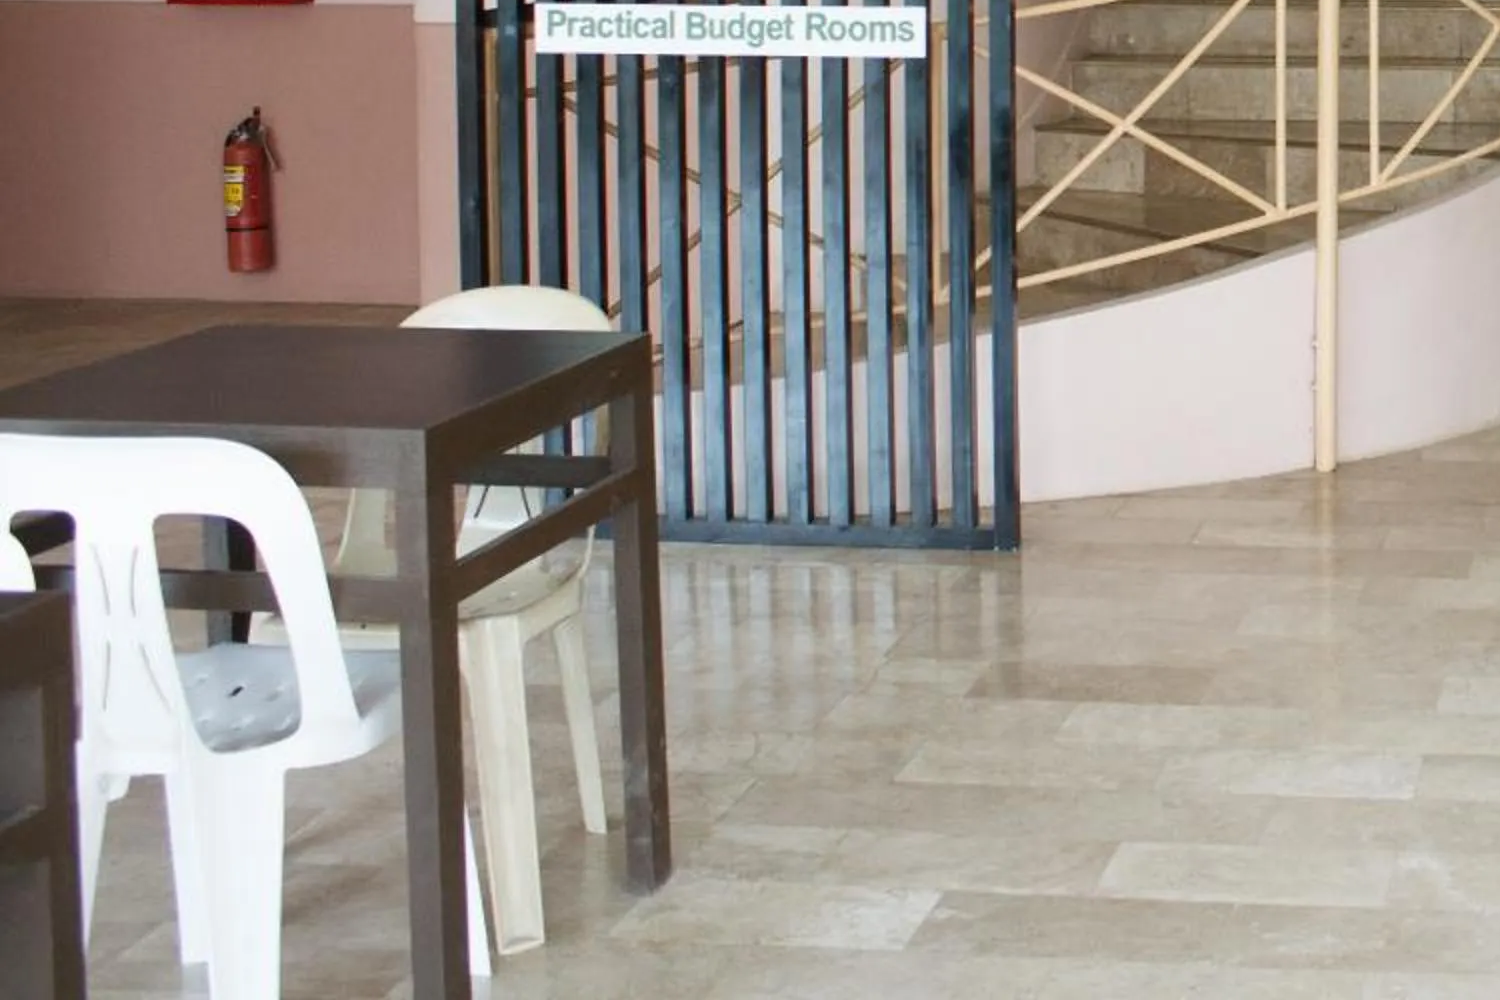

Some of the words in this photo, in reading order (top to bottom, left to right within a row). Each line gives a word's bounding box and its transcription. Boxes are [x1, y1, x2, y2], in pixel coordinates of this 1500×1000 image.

[546, 9, 676, 39] Practical
[686, 11, 794, 48] Budget
[806, 13, 915, 43] Rooms
